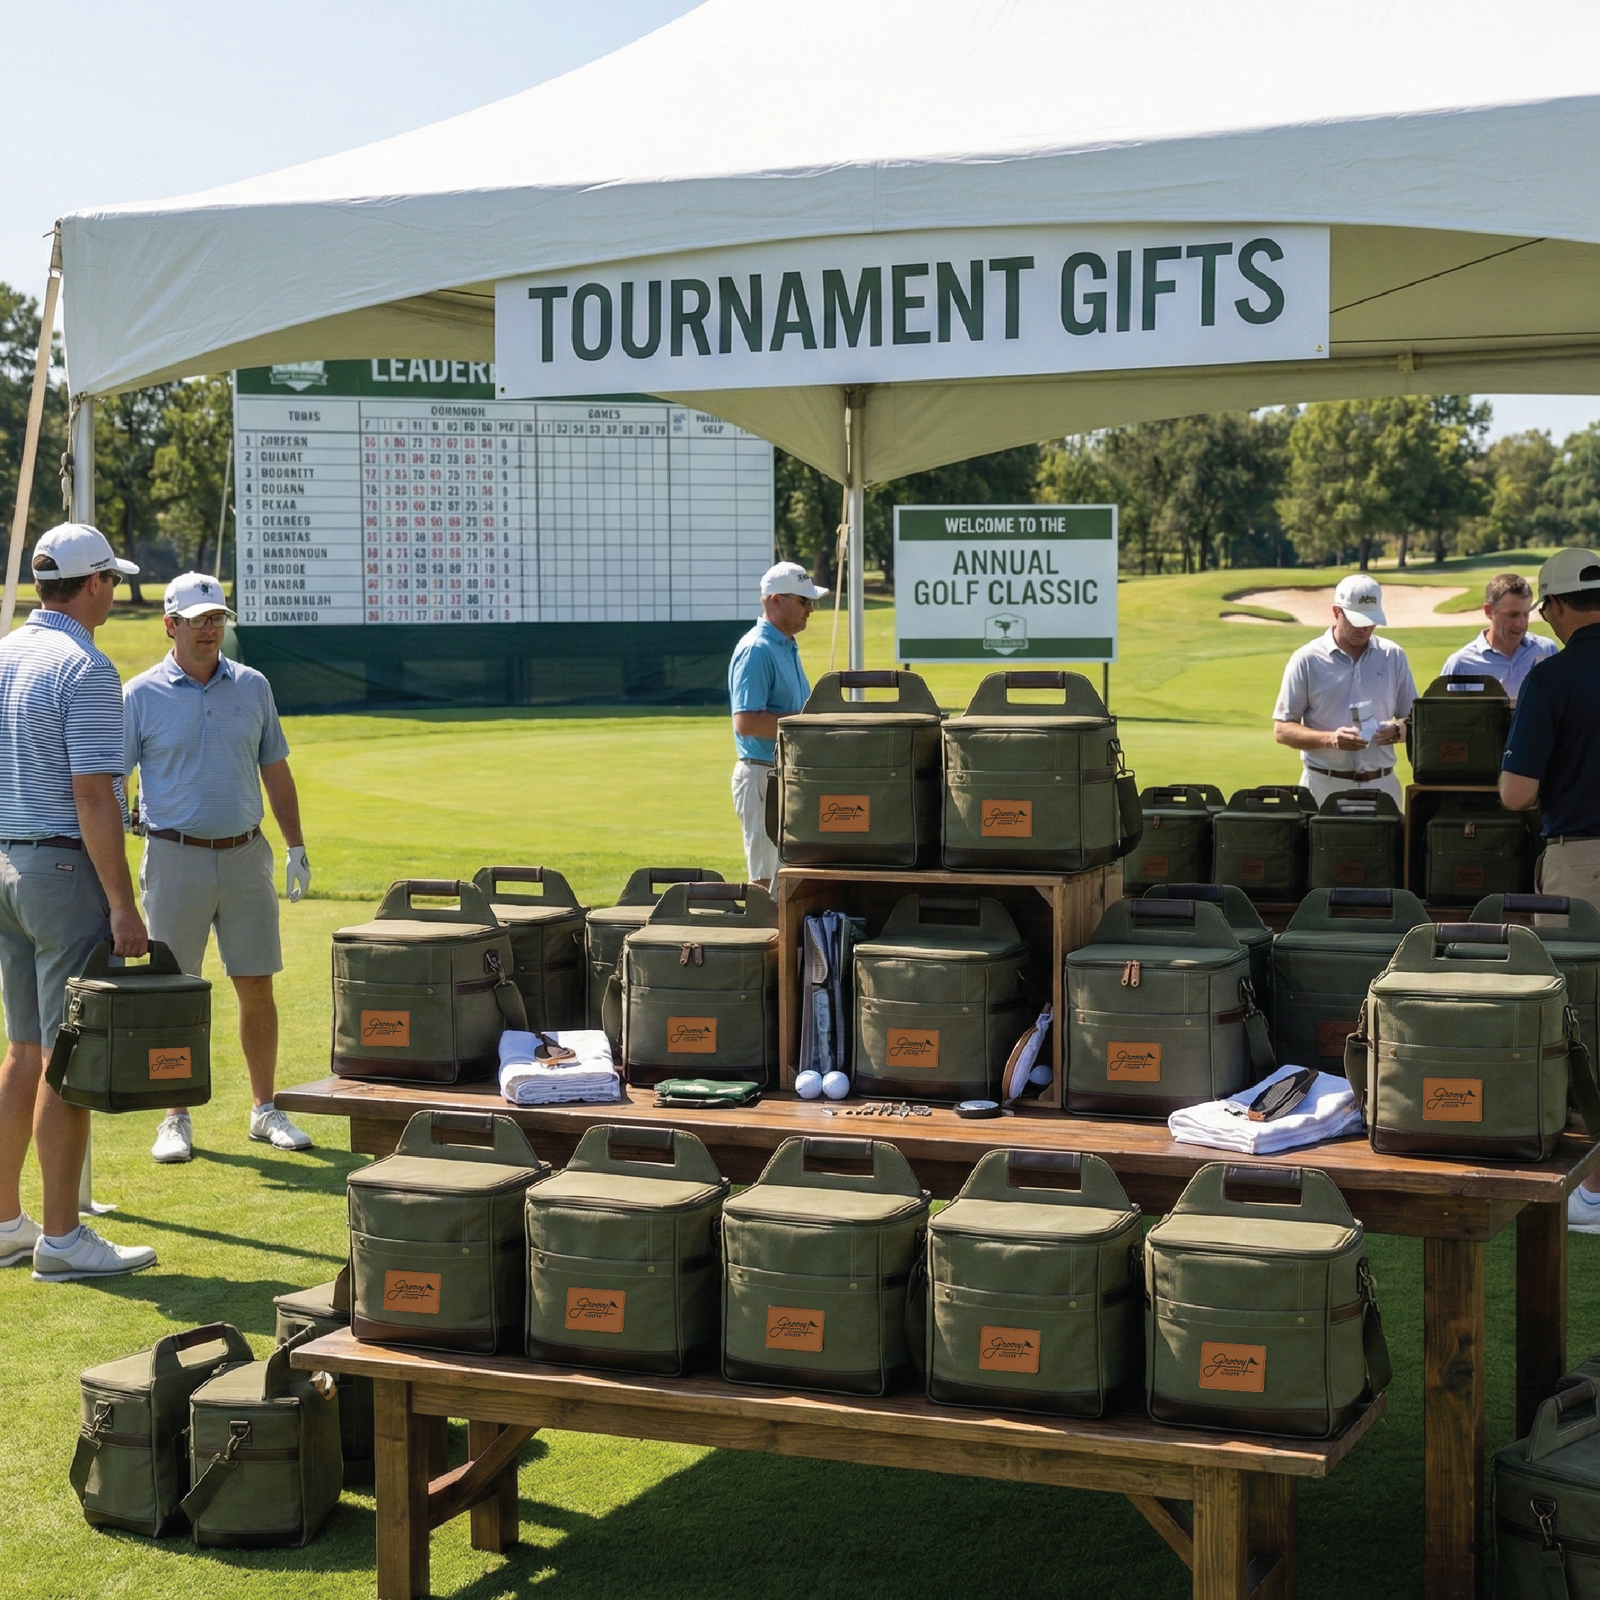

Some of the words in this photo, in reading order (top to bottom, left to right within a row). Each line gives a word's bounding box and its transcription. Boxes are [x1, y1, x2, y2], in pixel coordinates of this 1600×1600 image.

[528, 255, 1035, 363] TOURNAMENT
[1059, 237, 1284, 336] GIFTS
[246, 436, 250, 445] 1
[245, 452, 251, 461] 2
[245, 484, 252, 494] 4
[246, 500, 252, 510] 5
[246, 516, 252, 526] 6
[945, 518, 1014, 533] WELCOME
[1019, 518, 1036, 532] TO
[1040, 517, 1066, 532] THE
[247, 532, 253, 542] 7
[247, 548, 253, 558] 8
[247, 564, 253, 574] 9
[953, 550, 1059, 575] ANNUAL
[245, 580, 256, 590] 10
[914, 580, 978, 605] GOLF
[988, 579, 1098, 605] CLASSIC
[245, 596, 256, 606] 11
[246, 612, 256, 622] 12
[822, 803, 856, 822] Groovy
[984, 808, 1017, 827] Groovy
[363, 1018, 396, 1037] Groovy
[670, 1025, 703, 1043] Groovy
[889, 1037, 923, 1056] Groovy
[152, 1055, 180, 1072] Groovy
[1110, 1050, 1145, 1070] Groovy
[1426, 1088, 1465, 1109] Groovy
[387, 1280, 423, 1300] Groovy
[569, 1298, 607, 1318] Groovy
[769, 1317, 807, 1338] Groovy
[983, 1337, 1023, 1359] Groovy
[1203, 1353, 1246, 1377] Groovy
